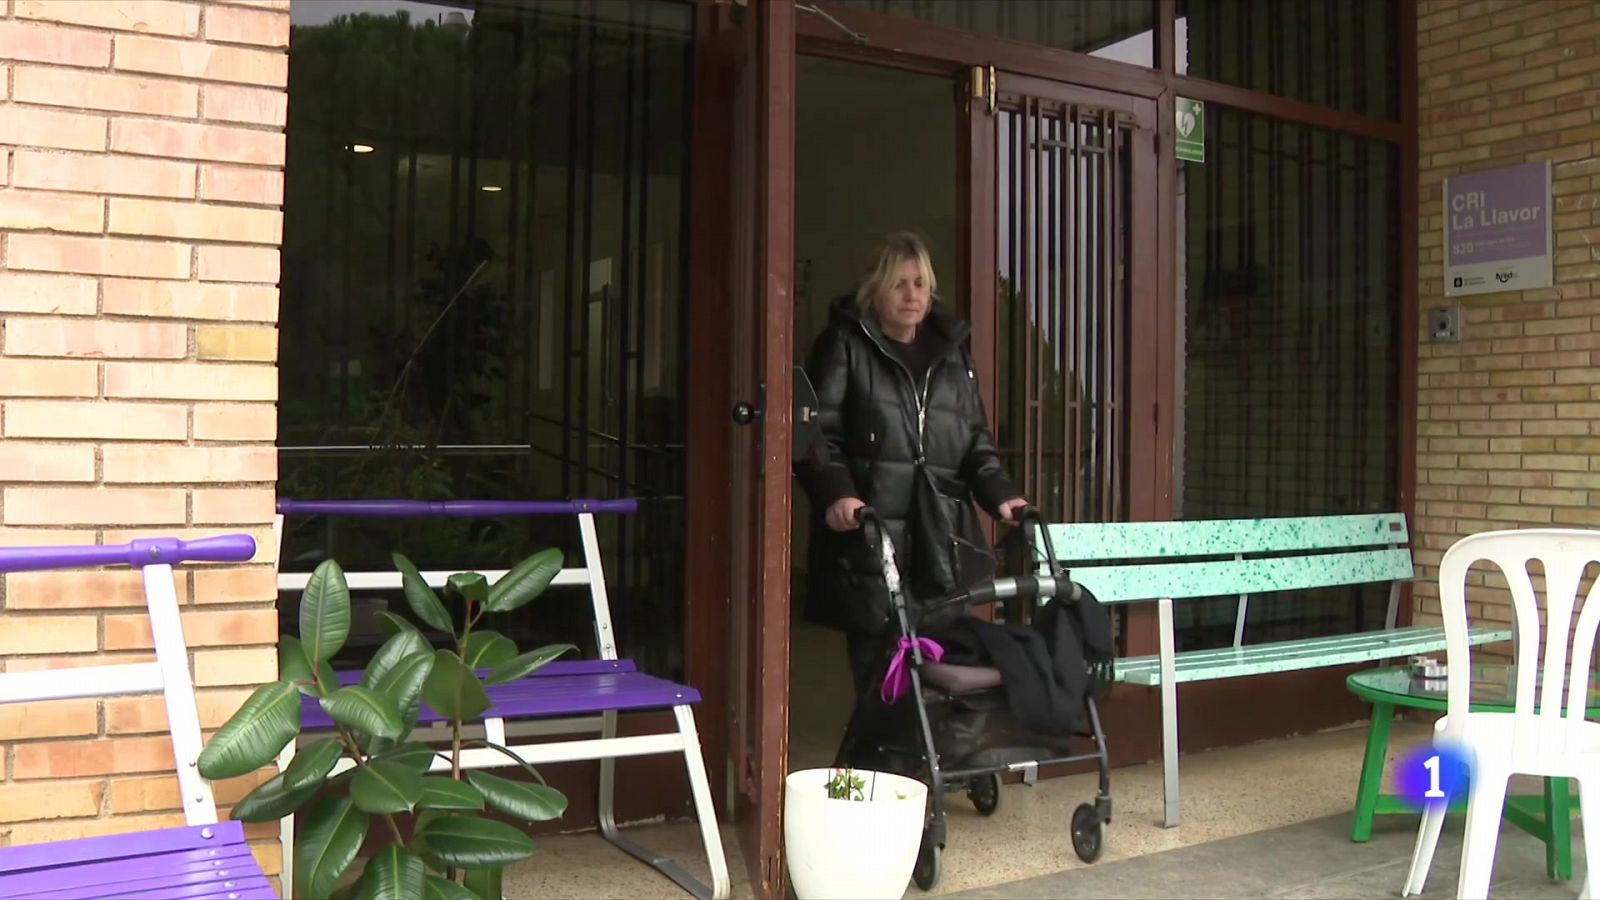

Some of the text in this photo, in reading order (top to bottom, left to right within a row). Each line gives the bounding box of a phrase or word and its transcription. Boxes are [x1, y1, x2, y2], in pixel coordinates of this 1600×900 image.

[1452, 191, 1485, 212] CRI
[1453, 206, 1540, 230] La Llavor
